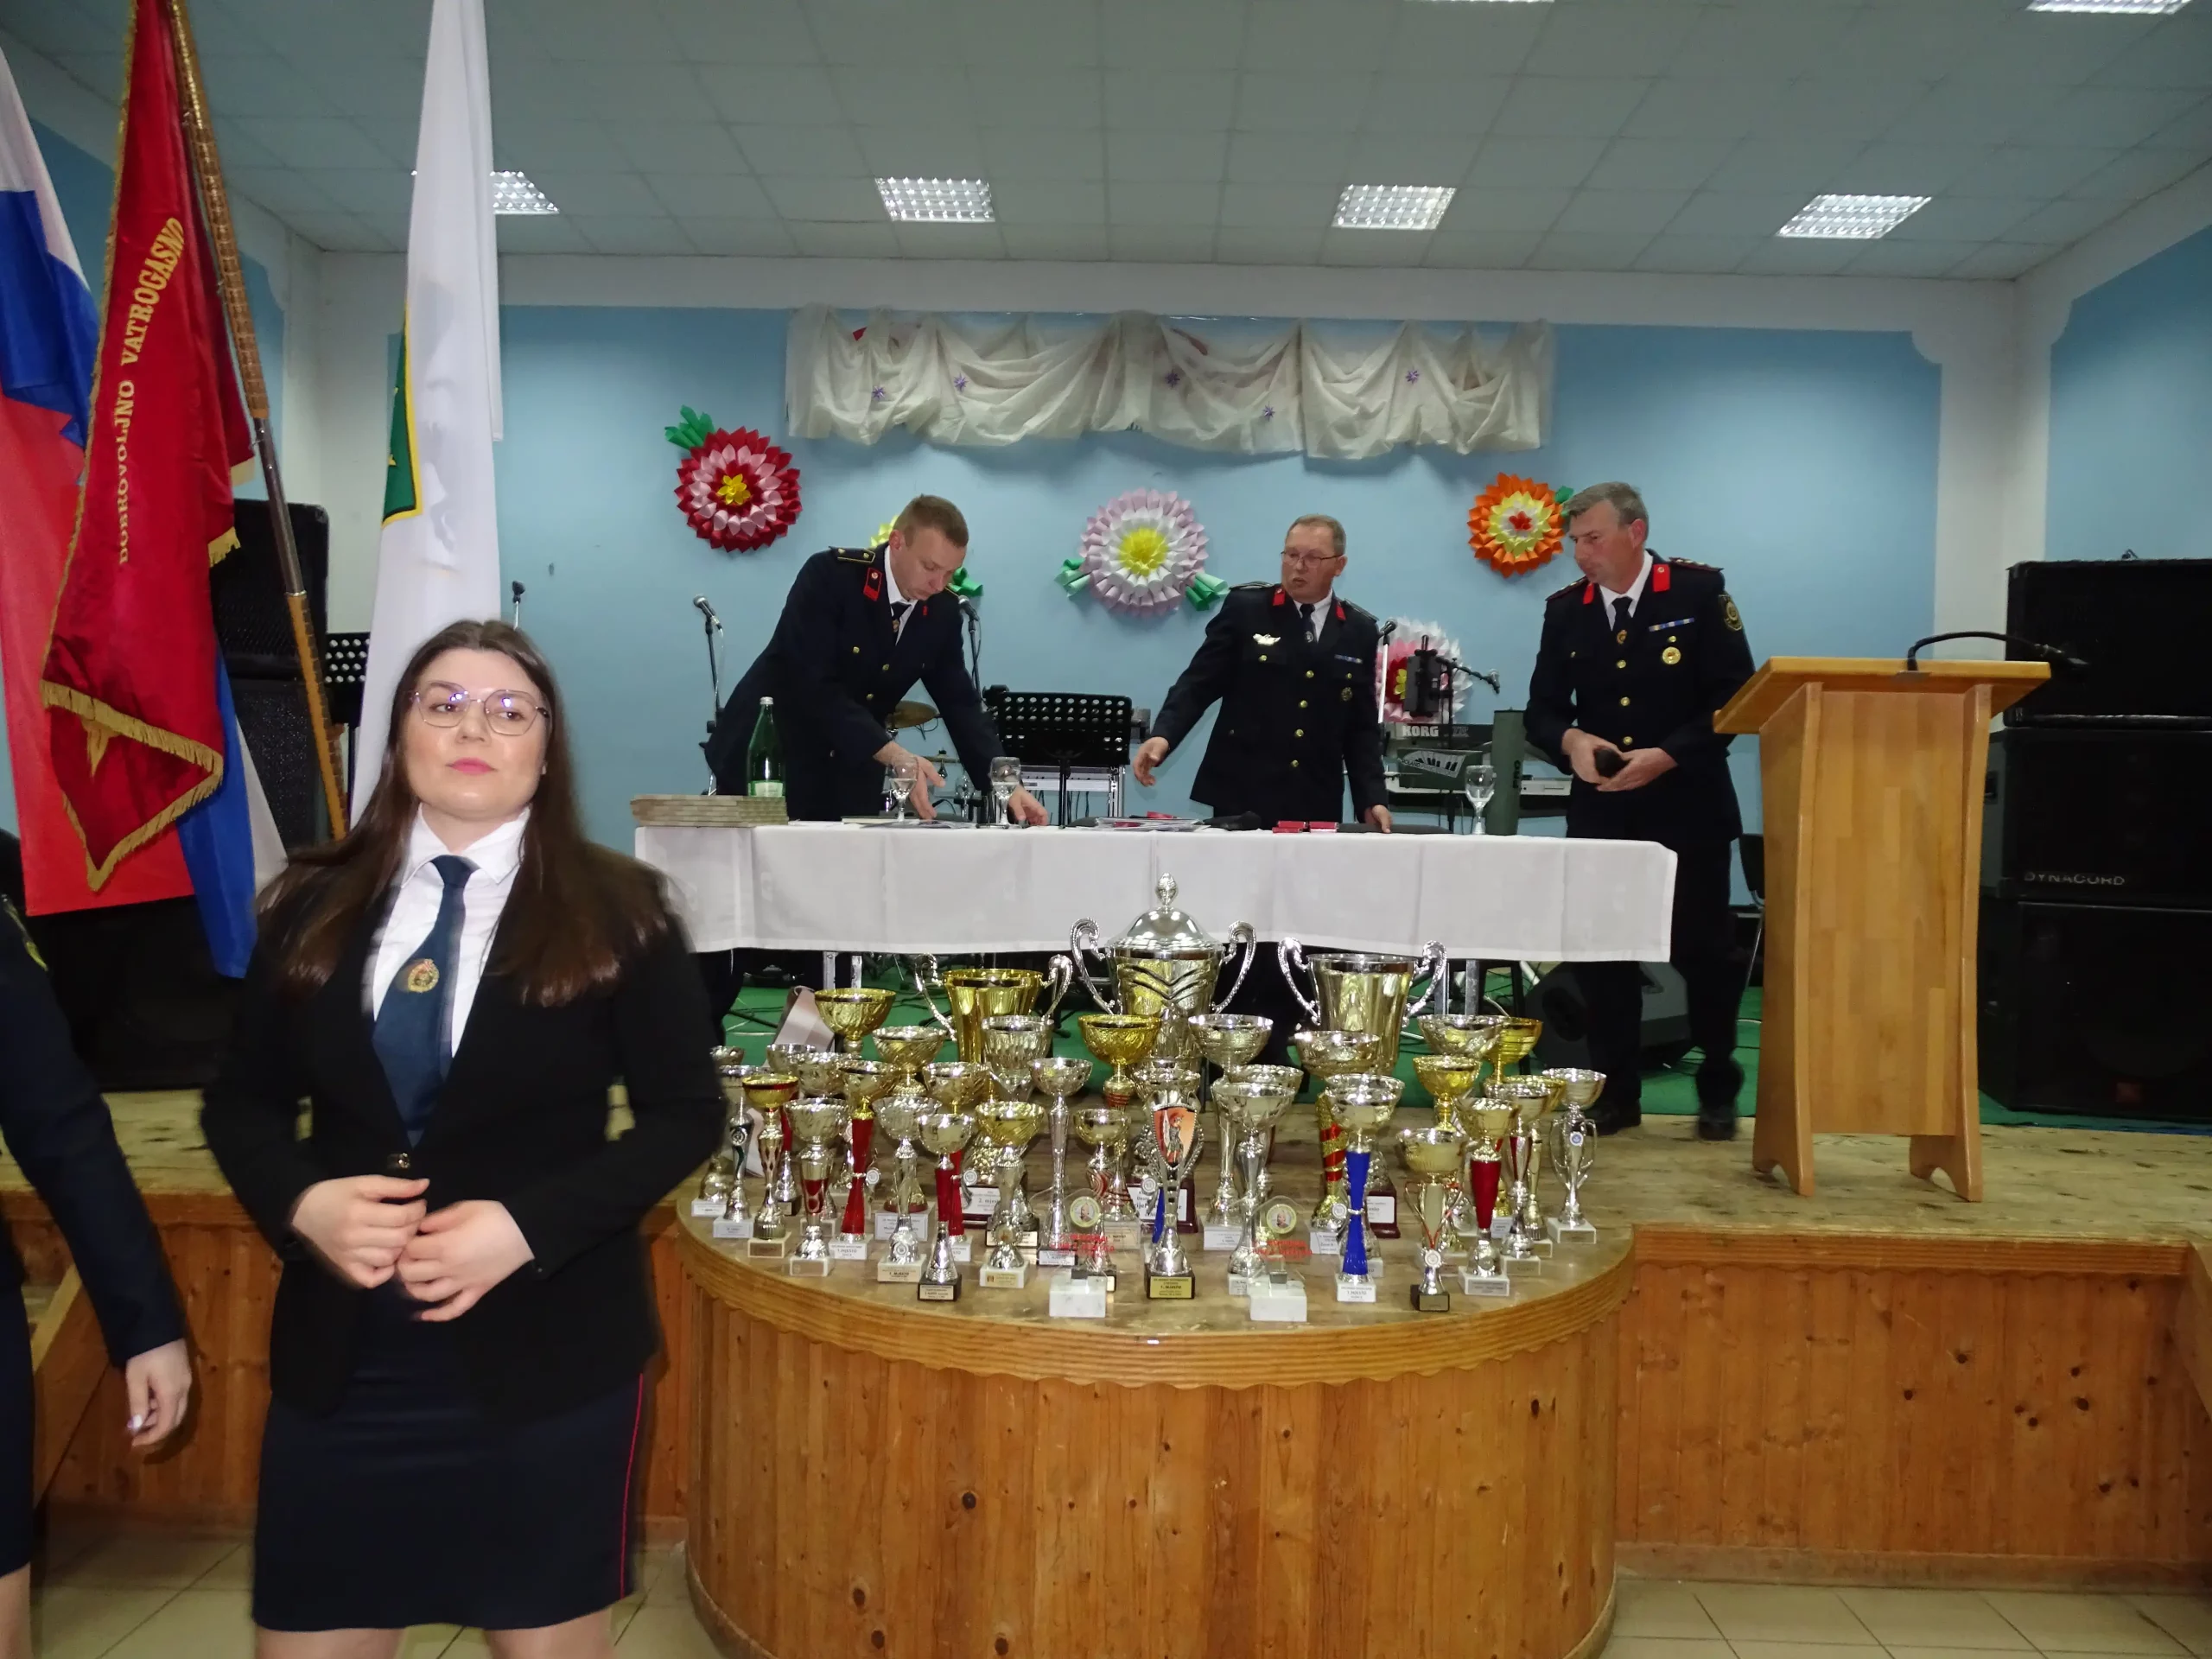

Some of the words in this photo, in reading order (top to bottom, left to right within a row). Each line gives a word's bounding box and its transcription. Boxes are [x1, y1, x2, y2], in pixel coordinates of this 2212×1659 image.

[121, 217, 185, 366] VATROGASNO
[113, 380, 135, 565] DOBROVOLJNO
[1402, 725, 1440, 737] KORG
